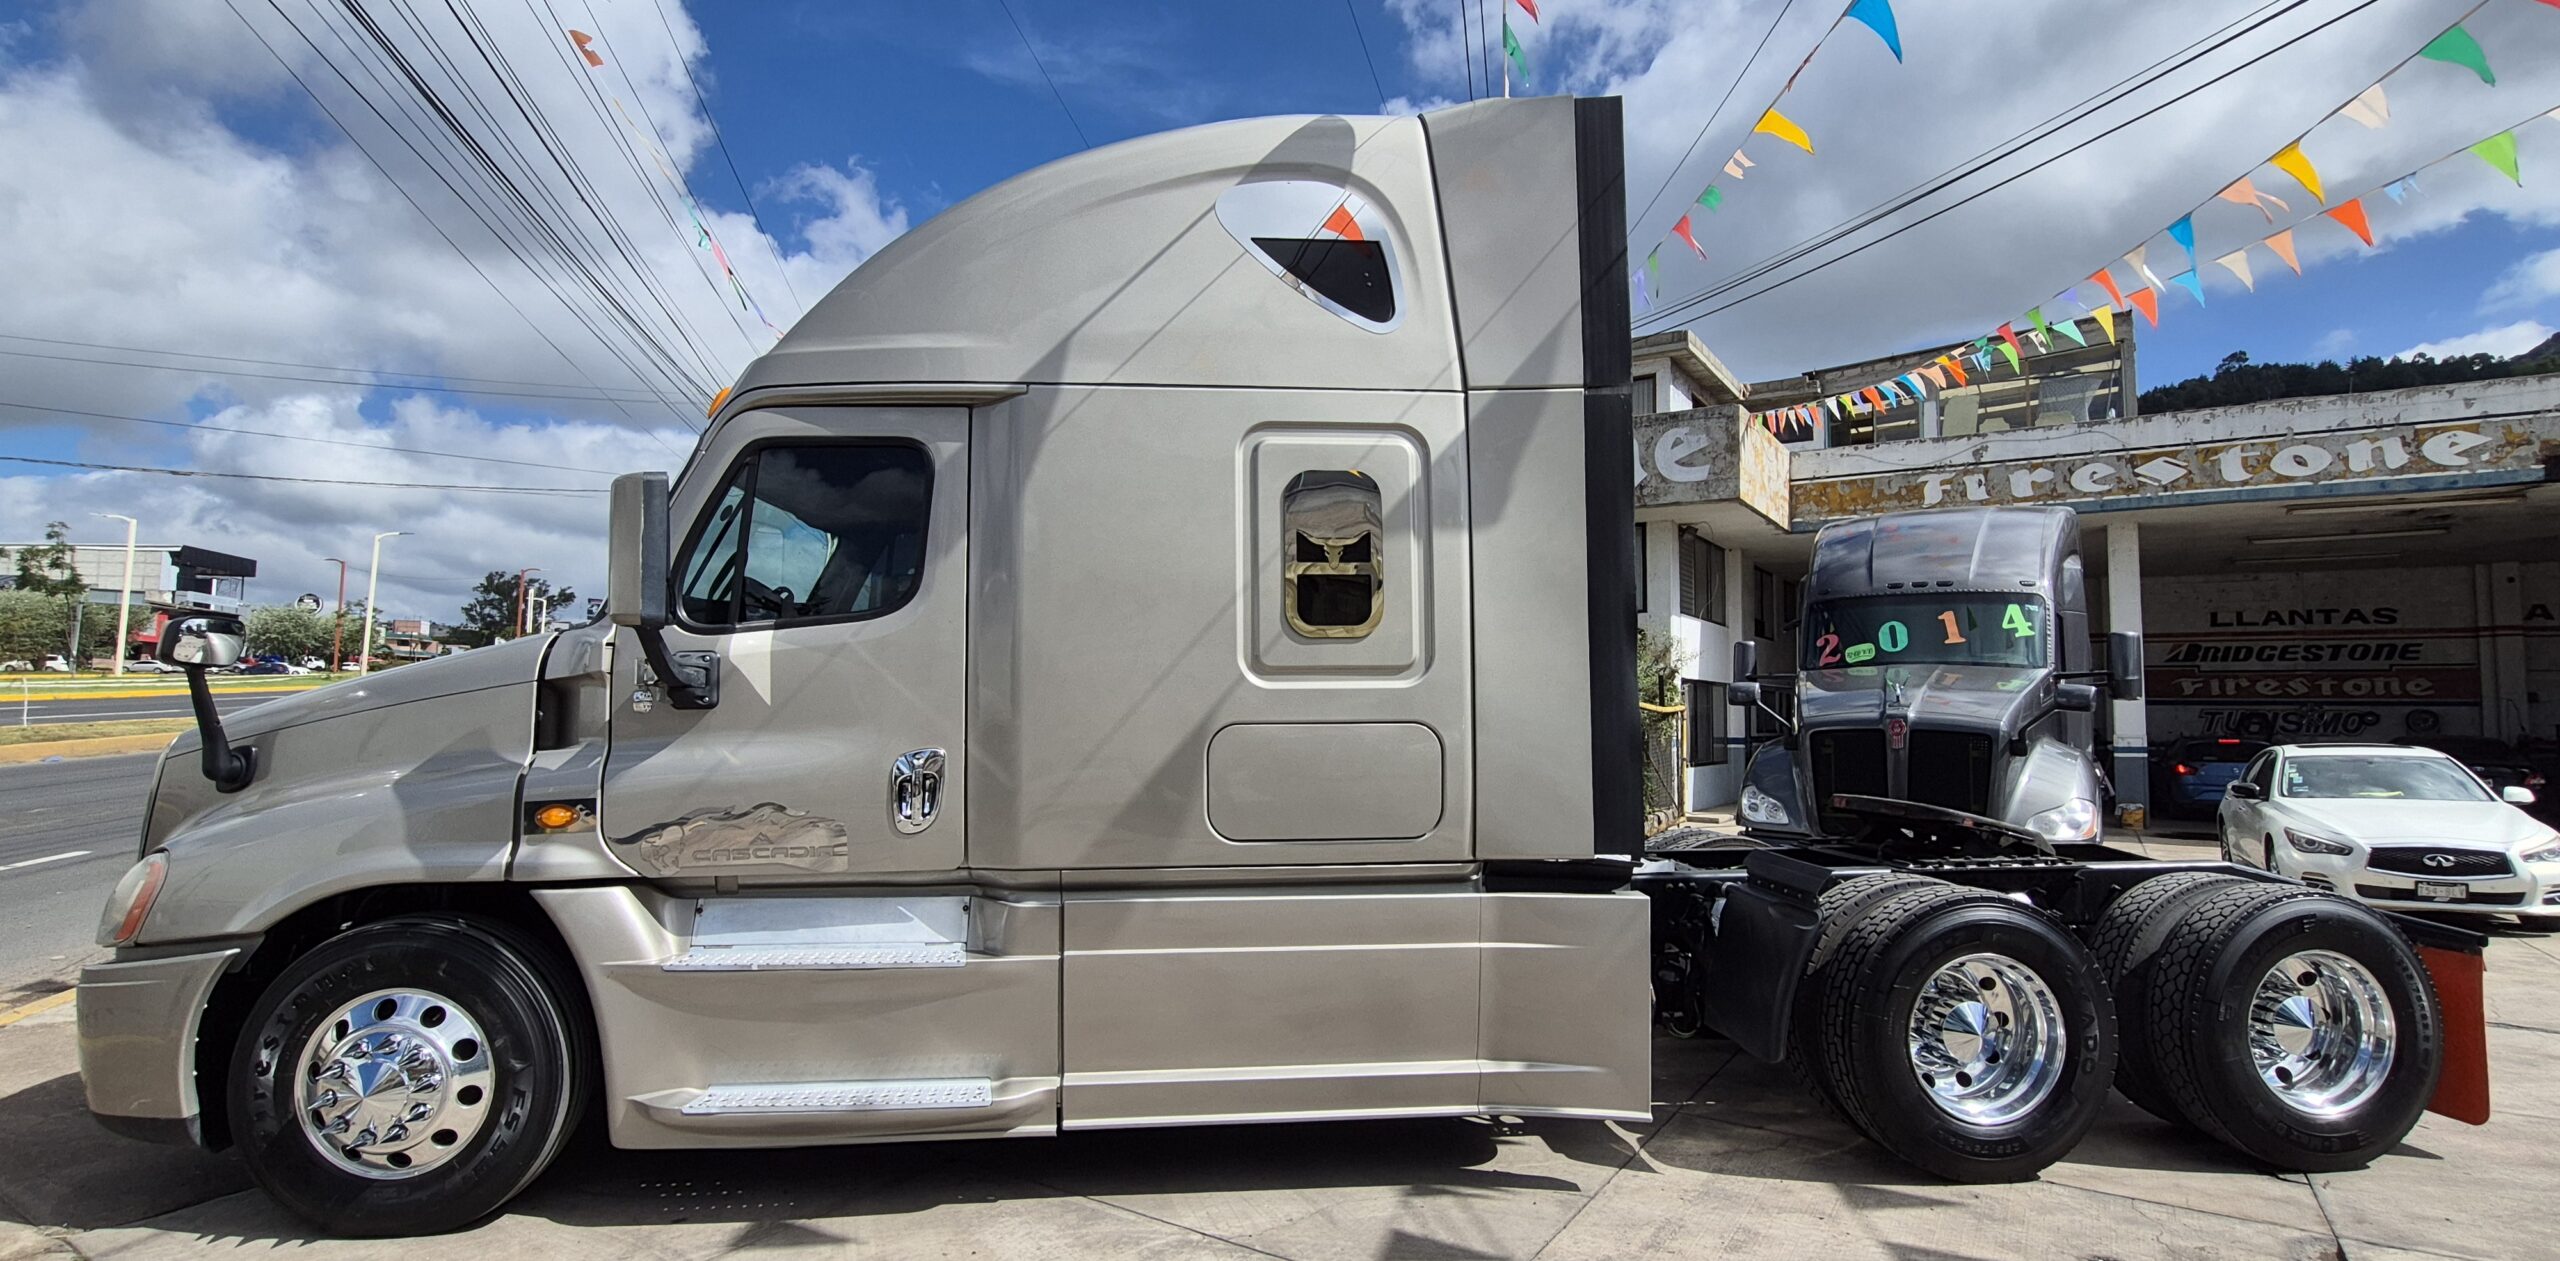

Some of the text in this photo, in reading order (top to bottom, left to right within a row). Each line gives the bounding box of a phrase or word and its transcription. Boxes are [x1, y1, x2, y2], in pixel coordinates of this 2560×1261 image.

[1917, 431, 2492, 507] Firestone
[2209, 607, 2399, 628] LLANTAS
[2163, 643, 2424, 664] BRIDGESTONE
[2172, 677, 2435, 697] Firestone
